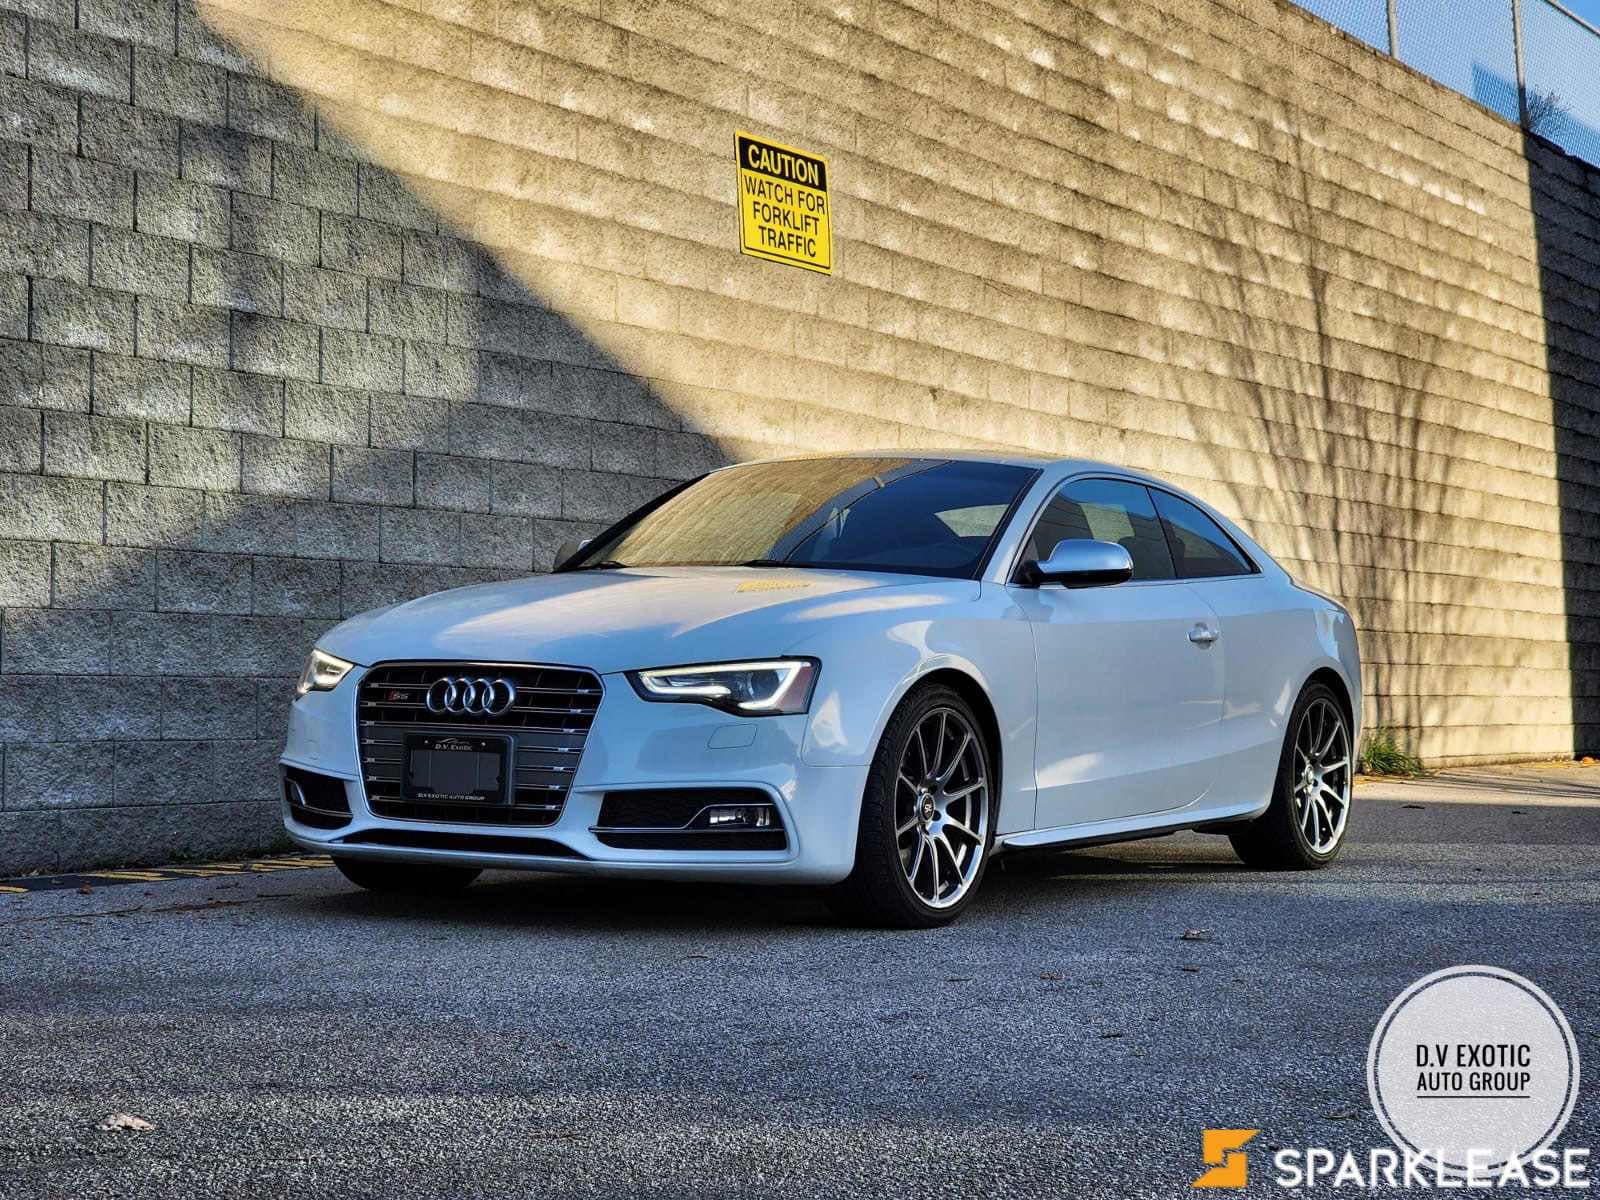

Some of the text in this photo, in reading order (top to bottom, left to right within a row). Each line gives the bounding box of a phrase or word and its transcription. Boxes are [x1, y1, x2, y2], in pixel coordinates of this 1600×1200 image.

[748, 144, 819, 186] CAUTION
[744, 175, 825, 214] WATCH FOR
[752, 201, 819, 235] FORKLIFT
[758, 225, 817, 257] TRAFFIC
